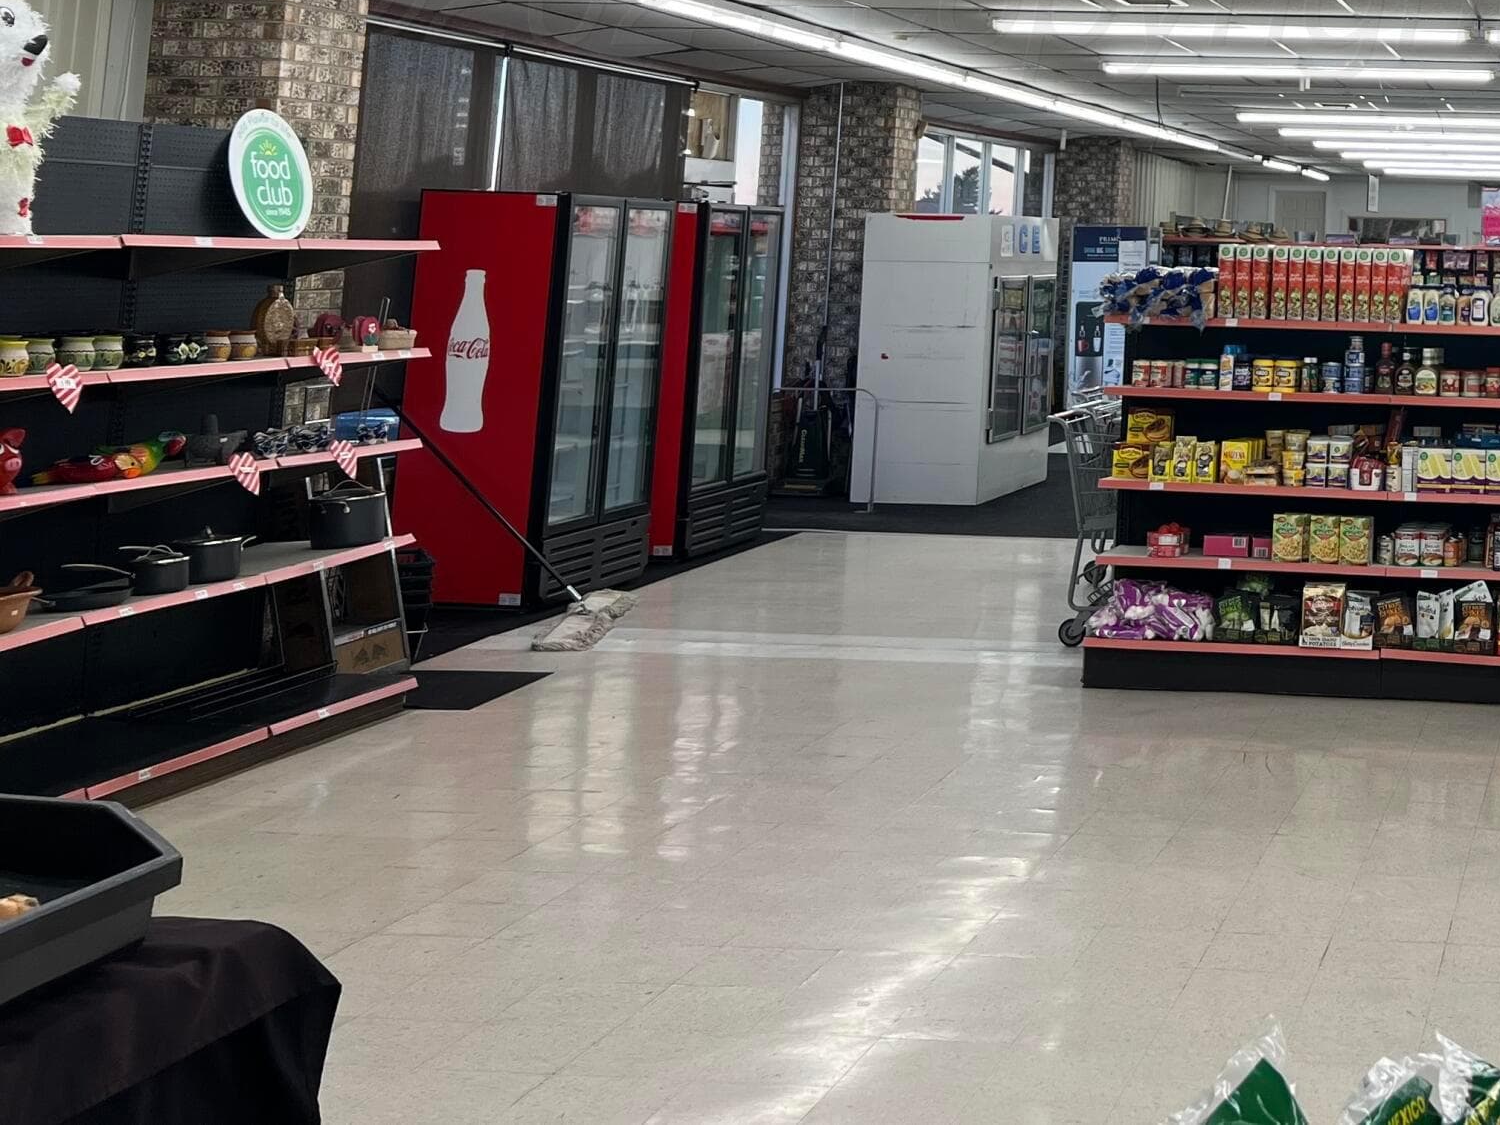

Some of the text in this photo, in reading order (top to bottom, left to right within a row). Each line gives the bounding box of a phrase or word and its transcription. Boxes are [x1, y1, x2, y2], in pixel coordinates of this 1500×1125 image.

[250, 151, 291, 180] food
[256, 179, 293, 206] club
[1012, 225, 1040, 254] CE
